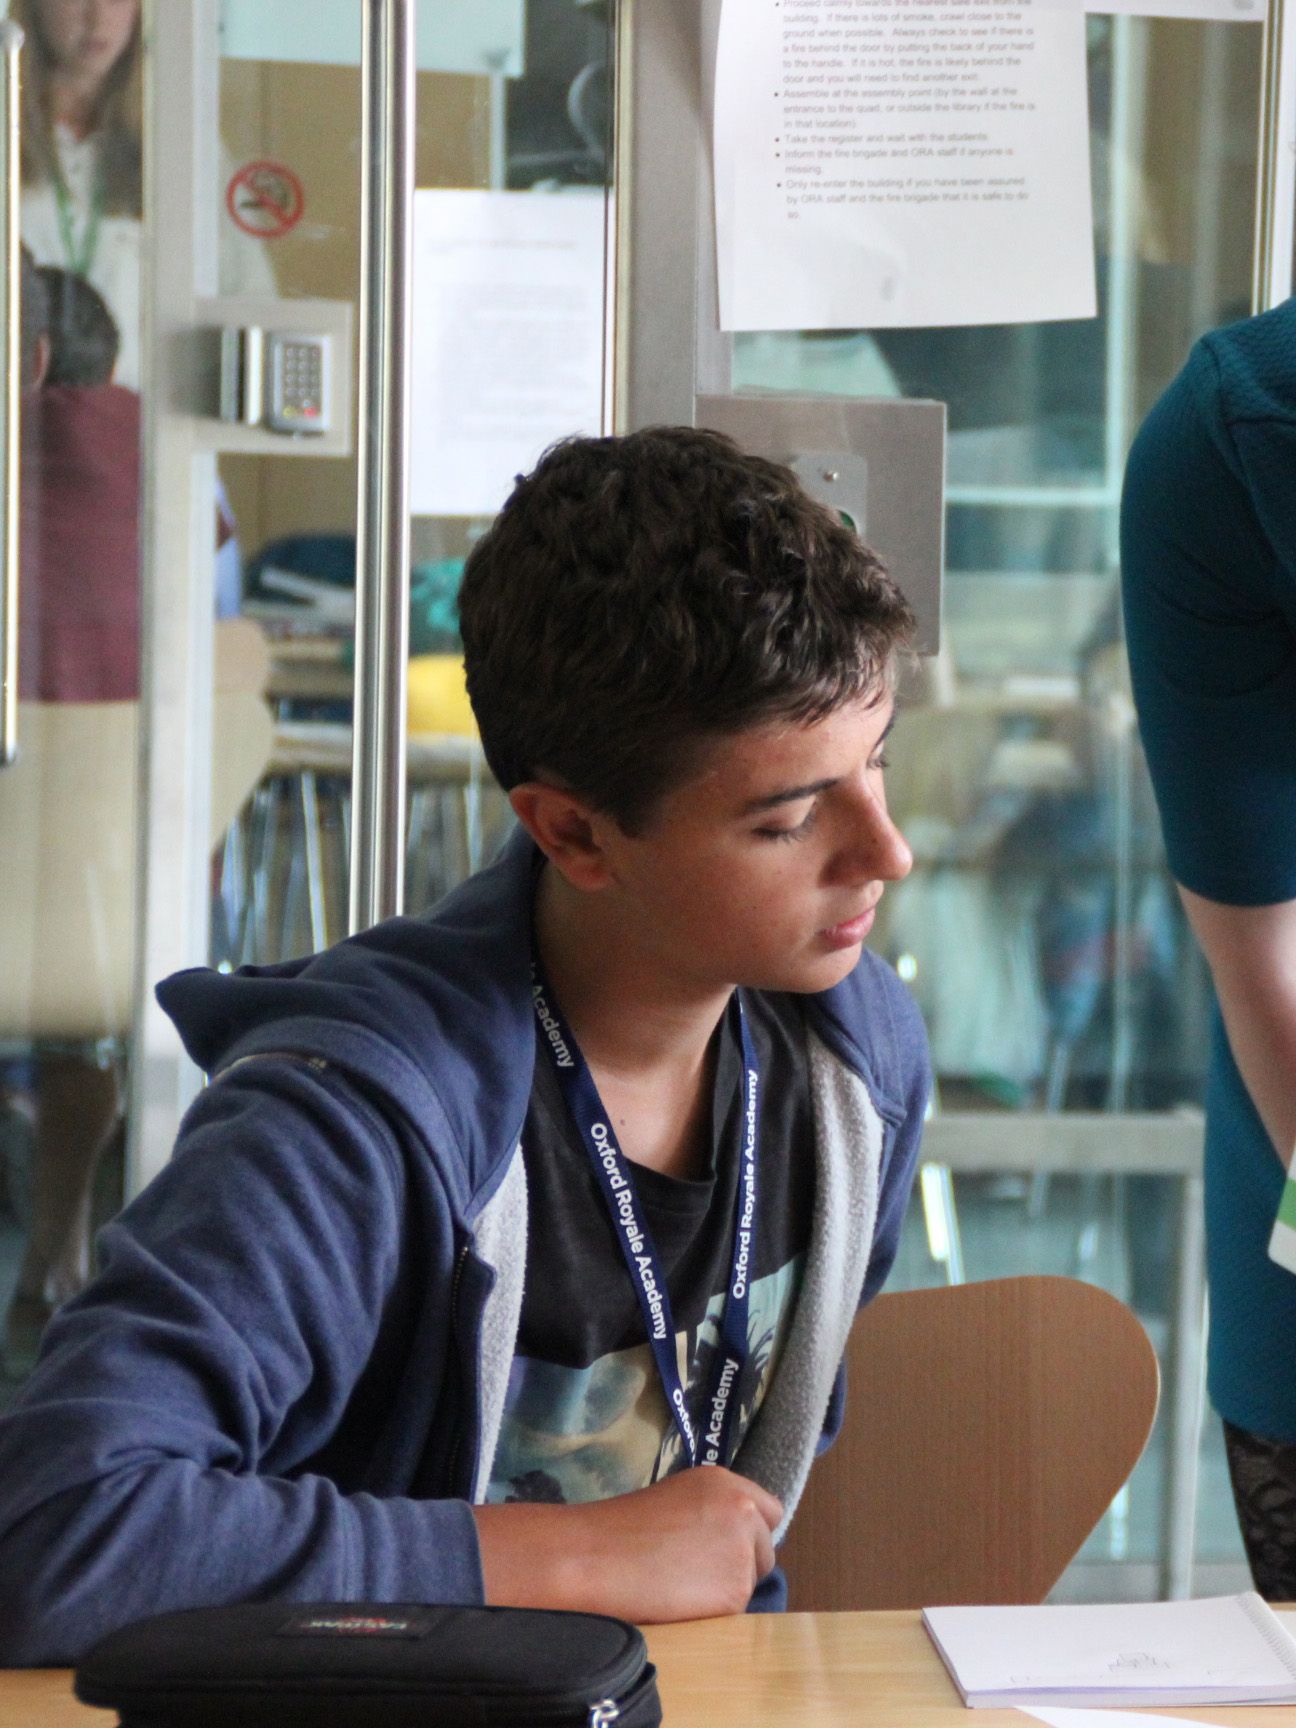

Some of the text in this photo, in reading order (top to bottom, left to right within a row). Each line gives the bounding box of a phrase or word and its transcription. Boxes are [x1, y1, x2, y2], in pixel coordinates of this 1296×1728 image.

[532, 985, 575, 1067] Academy
[590, 1122, 667, 1340] Oxford Royale Academy
[732, 1069, 758, 1300] Oxford Royale Academy
[704, 1357, 739, 1448] Academy
